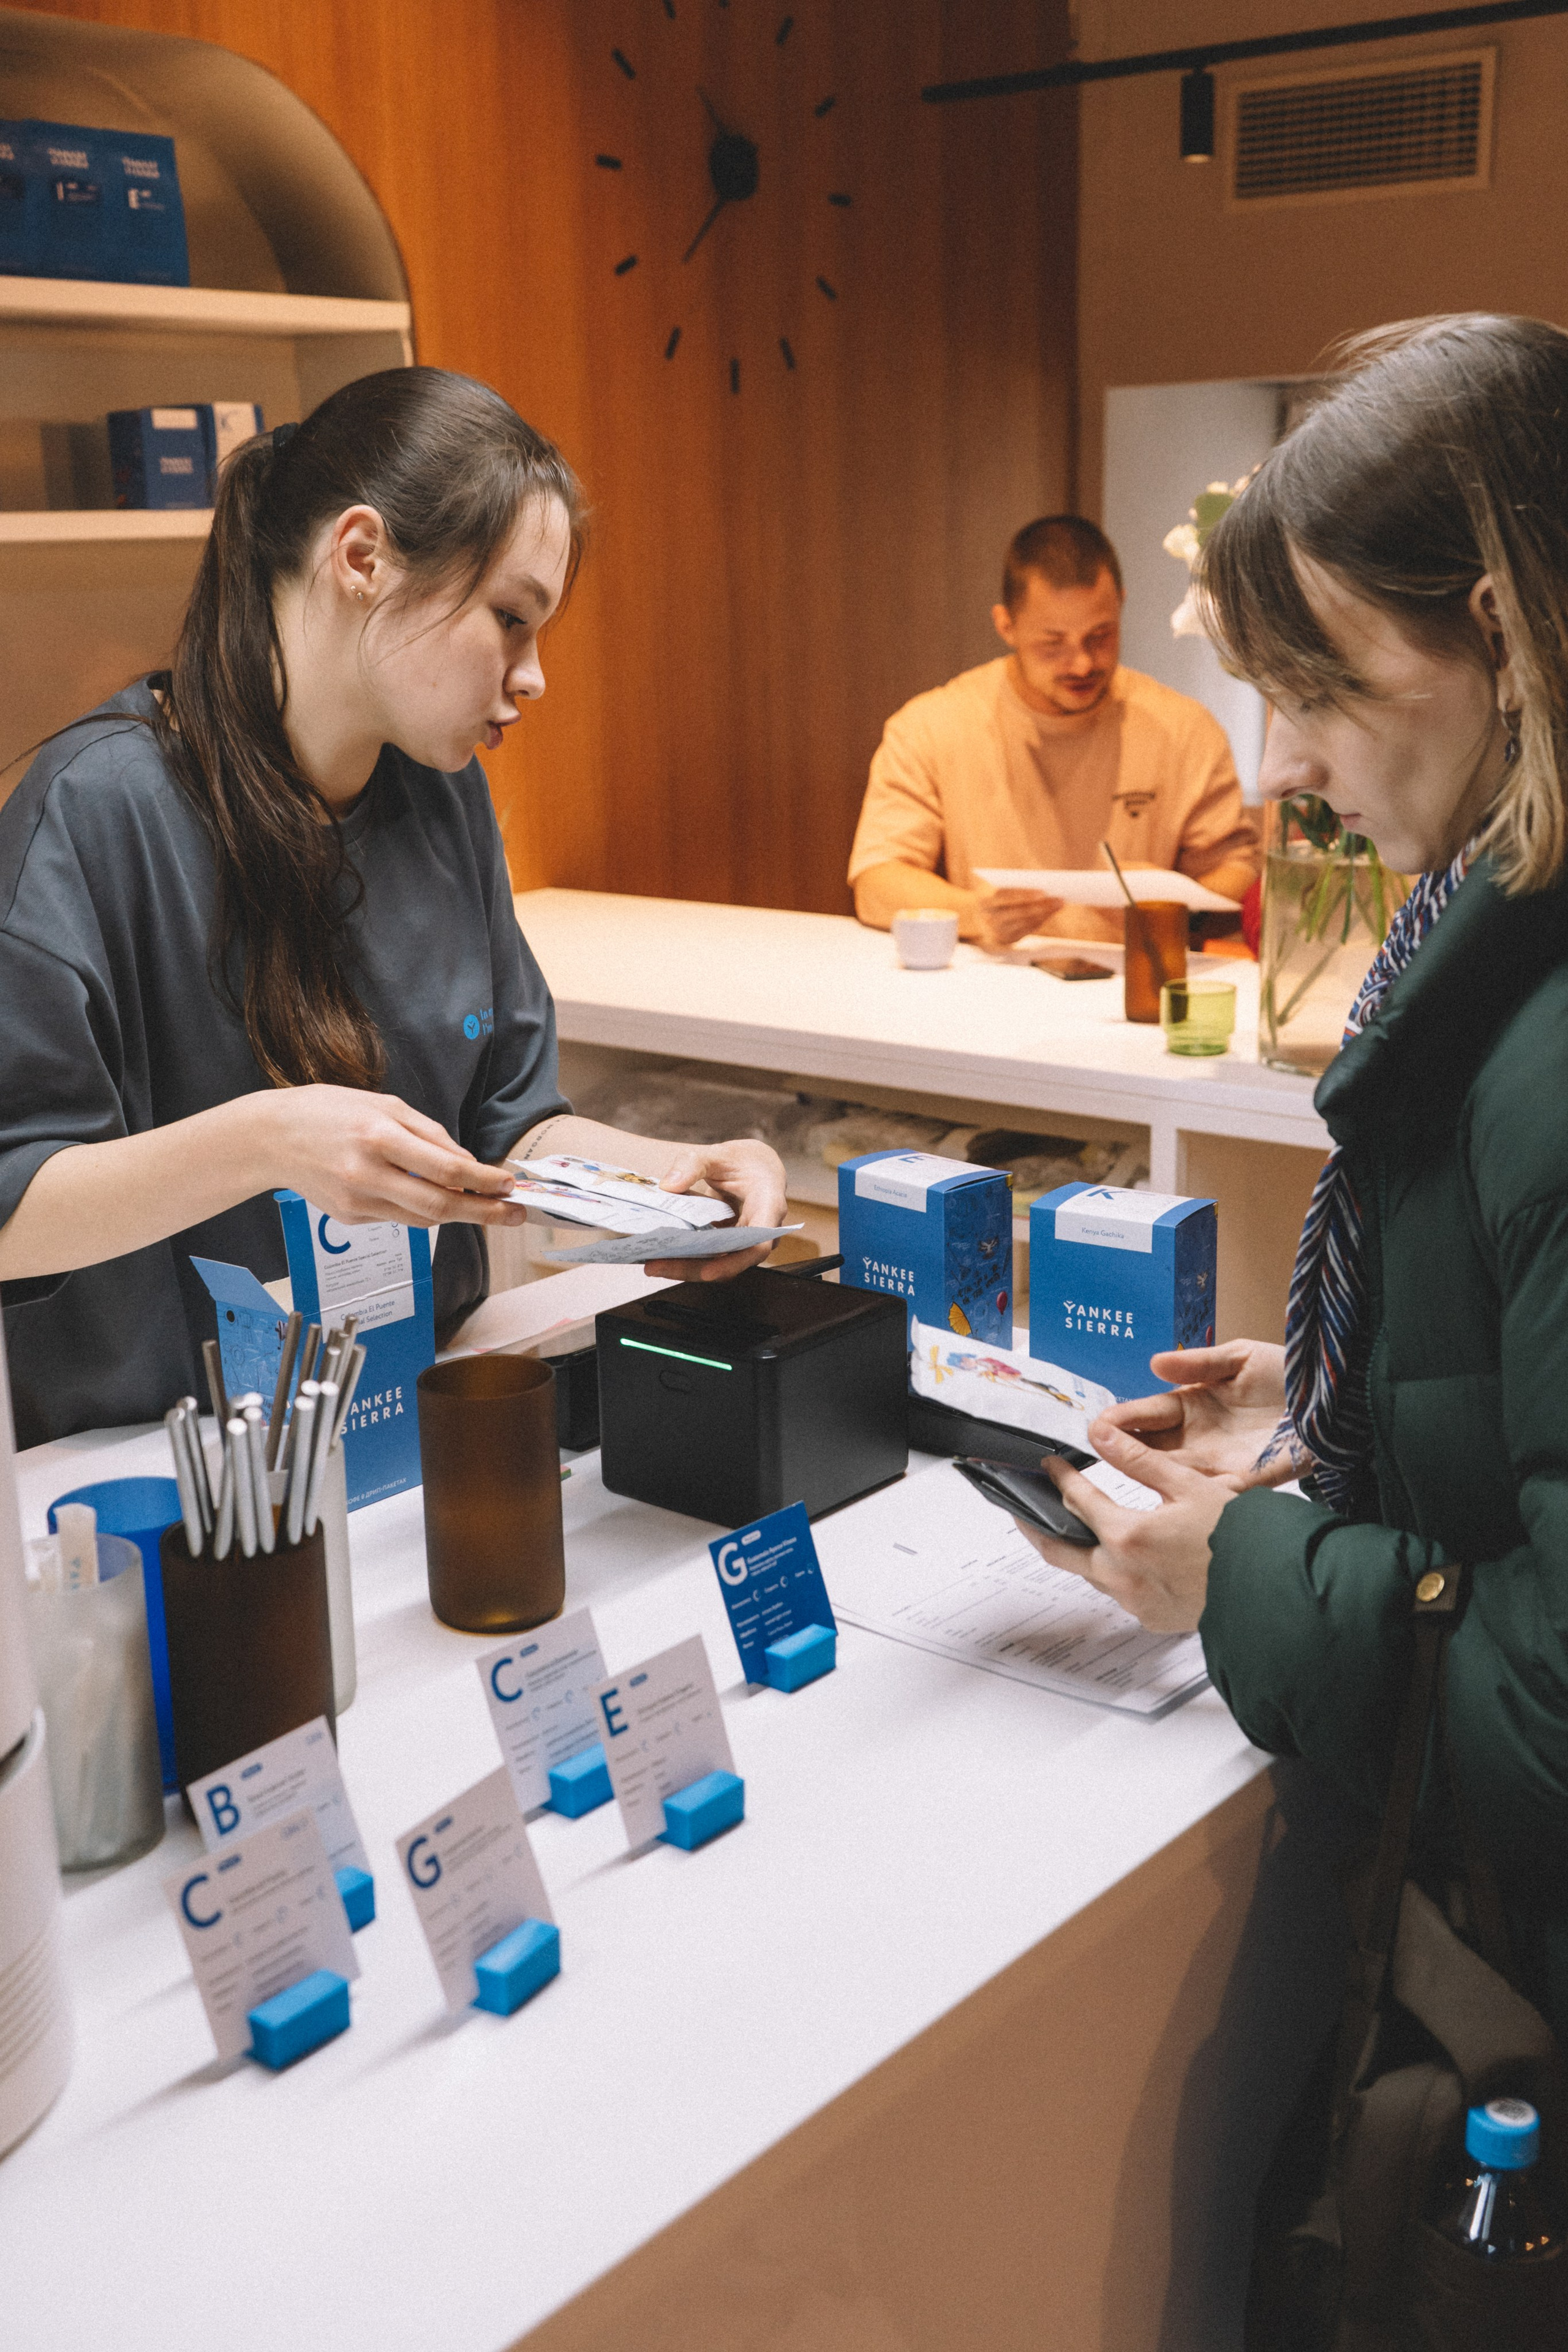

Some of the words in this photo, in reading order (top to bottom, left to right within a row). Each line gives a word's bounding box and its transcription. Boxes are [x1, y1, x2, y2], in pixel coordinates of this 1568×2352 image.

[1087, 1188, 1126, 1200] K
[1082, 1227, 1099, 1236] Kenya
[1101, 1230, 1124, 1239] Gachika
[862, 1256, 914, 1283] YANKEE
[864, 1272, 915, 1297] SIERRA
[366, 1311, 393, 1323] Selection
[375, 1300, 395, 1311] Puente
[1063, 1300, 1133, 1324] YANKEE
[1065, 1317, 1134, 1339] SIERRA
[350, 1386, 402, 1415] ANKEE
[347, 1494, 361, 1505] ОФЕ
[718, 1542, 748, 1586] G
[491, 1657, 523, 1703] C
[600, 1687, 628, 1737] E
[206, 1784, 241, 1836] B
[407, 1835, 442, 1889] G
[181, 1872, 222, 1928] C
